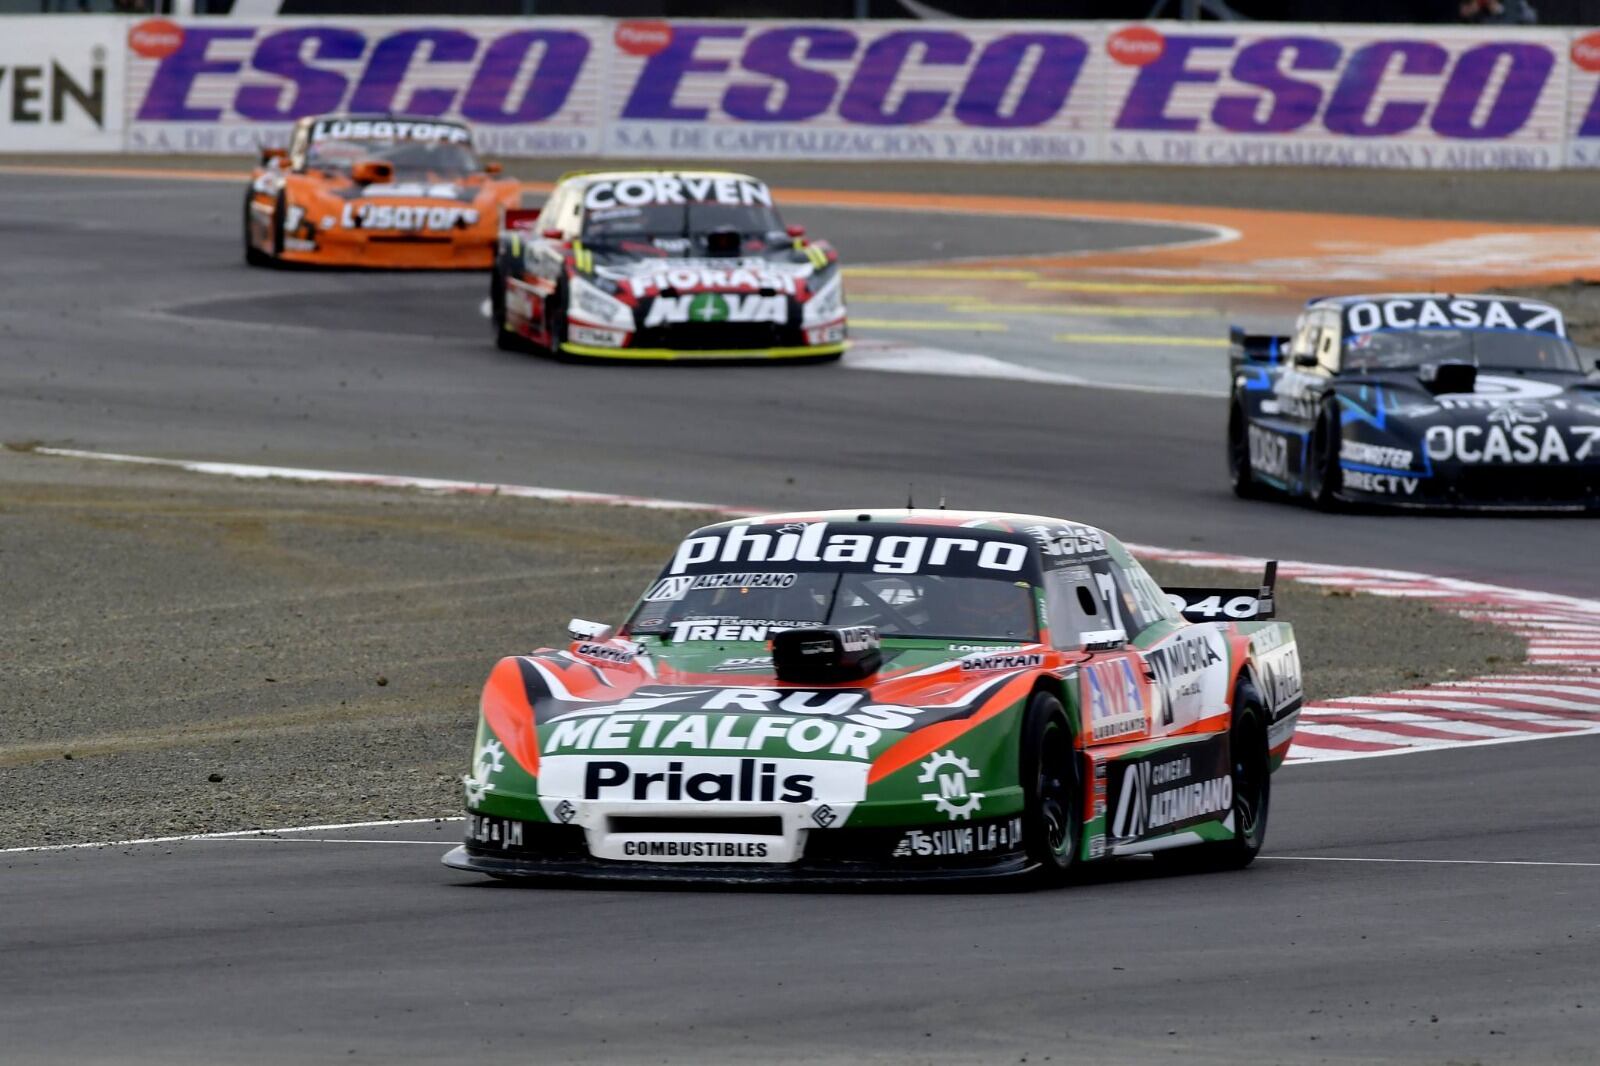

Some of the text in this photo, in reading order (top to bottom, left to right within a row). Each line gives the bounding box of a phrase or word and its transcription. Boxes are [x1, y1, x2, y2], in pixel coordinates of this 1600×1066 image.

[0, 60, 105, 129] EN
[136, 27, 590, 123] ESCO
[621, 26, 1090, 128] ESCO
[1113, 36, 1556, 139] ESCO
[669, 127, 702, 149] DE
[585, 179, 772, 209] CORVEN
[670, 522, 1027, 574] philagro
[695, 573, 797, 588] ALTAMIRANO
[545, 713, 882, 759] METALFOR
[584, 758, 815, 803] Prialis
[623, 840, 768, 857] COMBUSTIBLES
